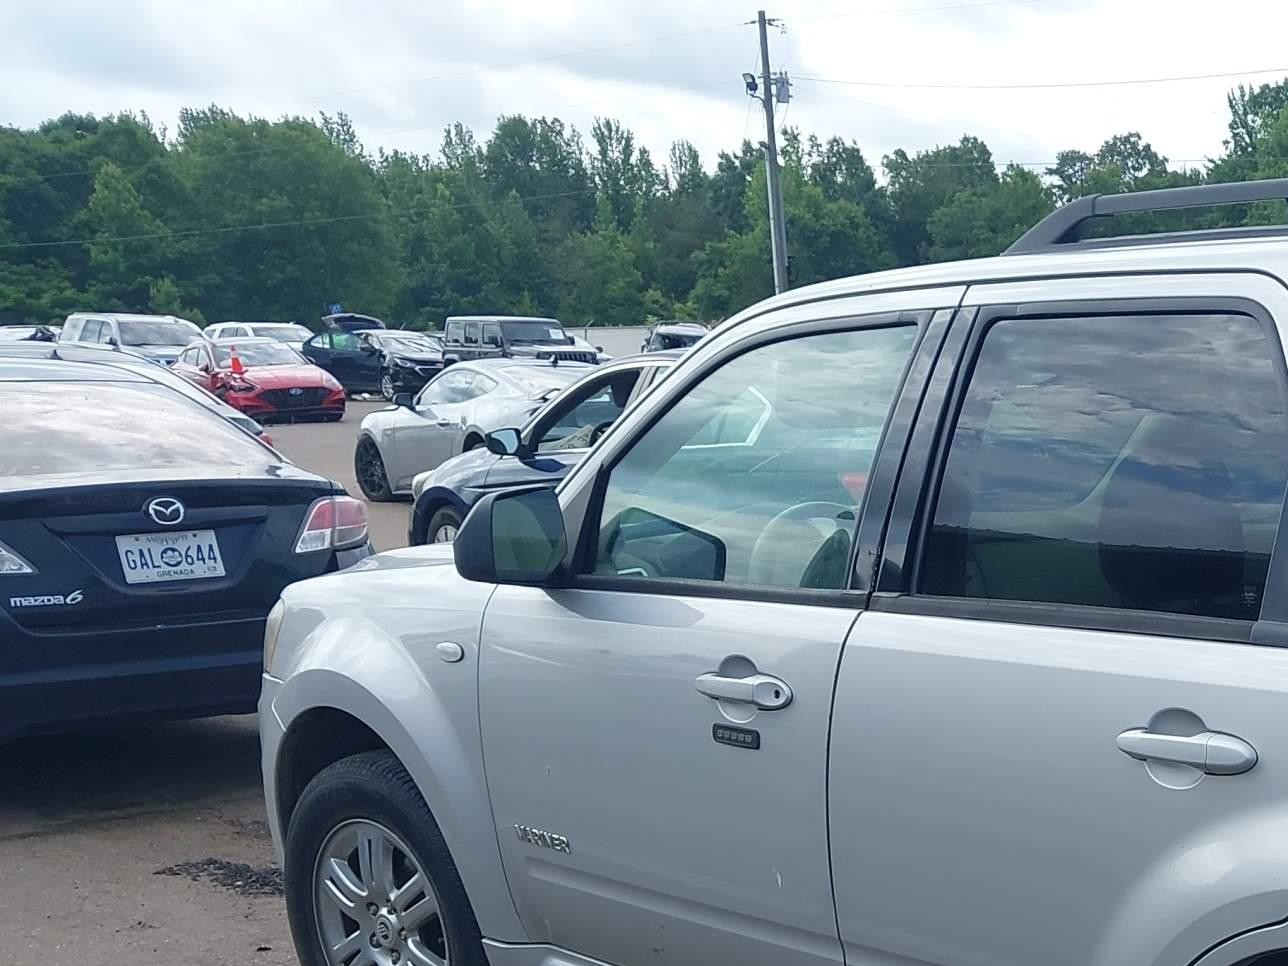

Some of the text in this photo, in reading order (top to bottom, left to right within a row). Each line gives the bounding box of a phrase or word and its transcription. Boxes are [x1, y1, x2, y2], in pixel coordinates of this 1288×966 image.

[124, 543, 218, 570] GAL 644
[156, 568, 196, 578] GRENADA
